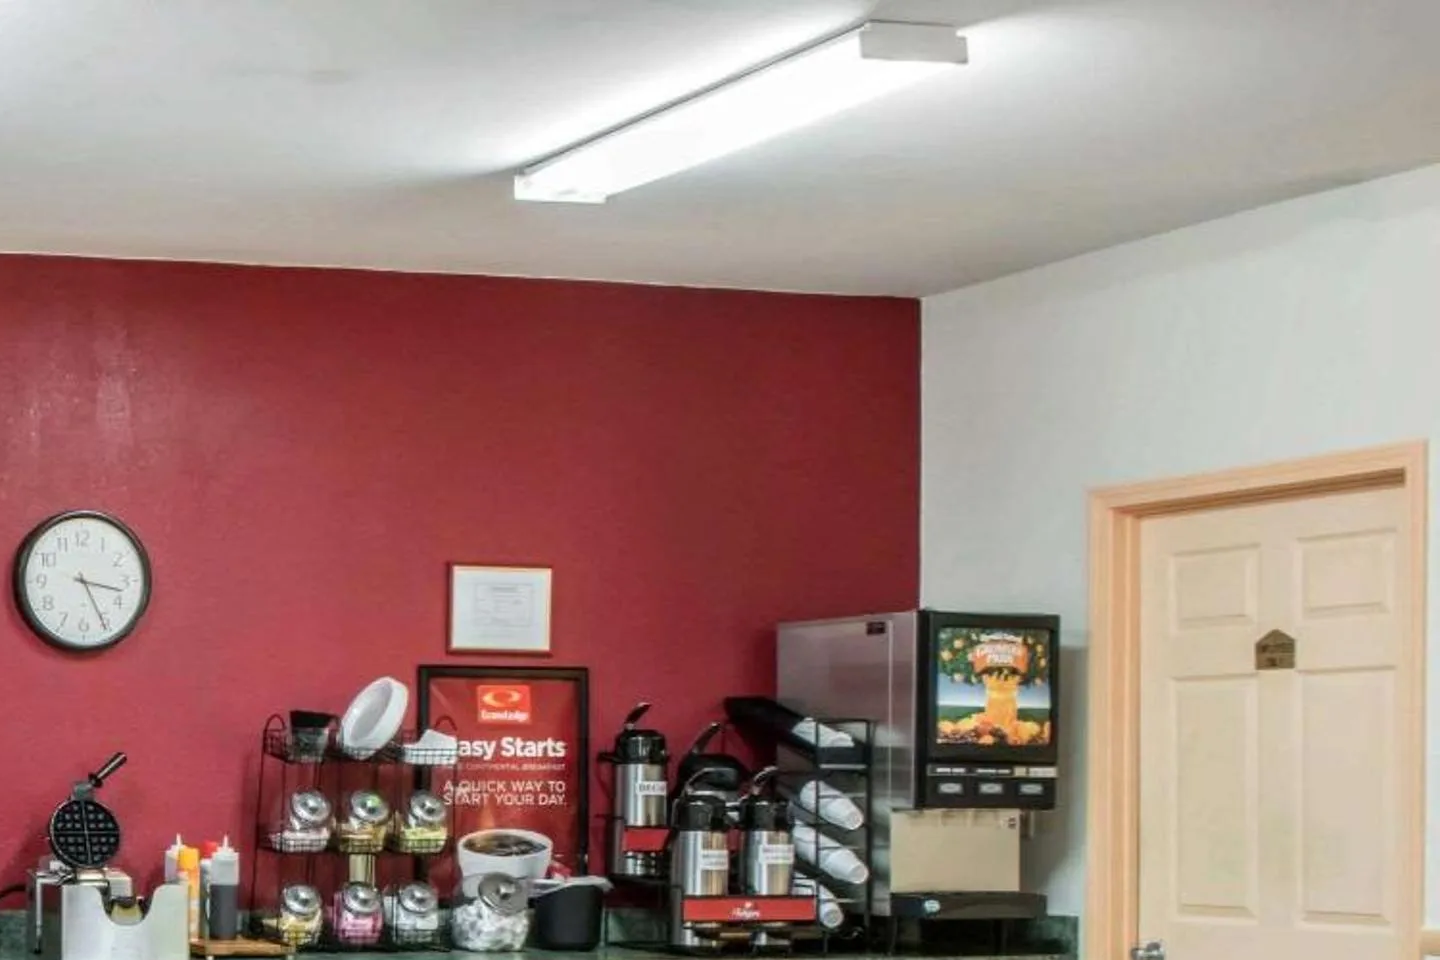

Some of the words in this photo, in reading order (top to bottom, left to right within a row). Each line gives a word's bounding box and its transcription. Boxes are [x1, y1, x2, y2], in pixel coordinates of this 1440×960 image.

[58, 538, 68, 552] 11
[75, 530, 90, 547] 12
[38, 553, 56, 567] 10
[36, 574, 47, 588] 9
[122, 575, 130, 588] 3
[43, 596, 54, 611] 8
[113, 596, 122, 609] 4
[60, 612, 68, 625] 7
[78, 618, 90, 632] 6
[456, 739, 497, 761] asy
[501, 737, 566, 757] Starts
[443, 781, 454, 792] A
[459, 781, 505, 793] QUICK
[511, 781, 543, 792] WAY
[548, 781, 565, 793] TO
[443, 793, 490, 805] START
[495, 794, 534, 805] YOUR
